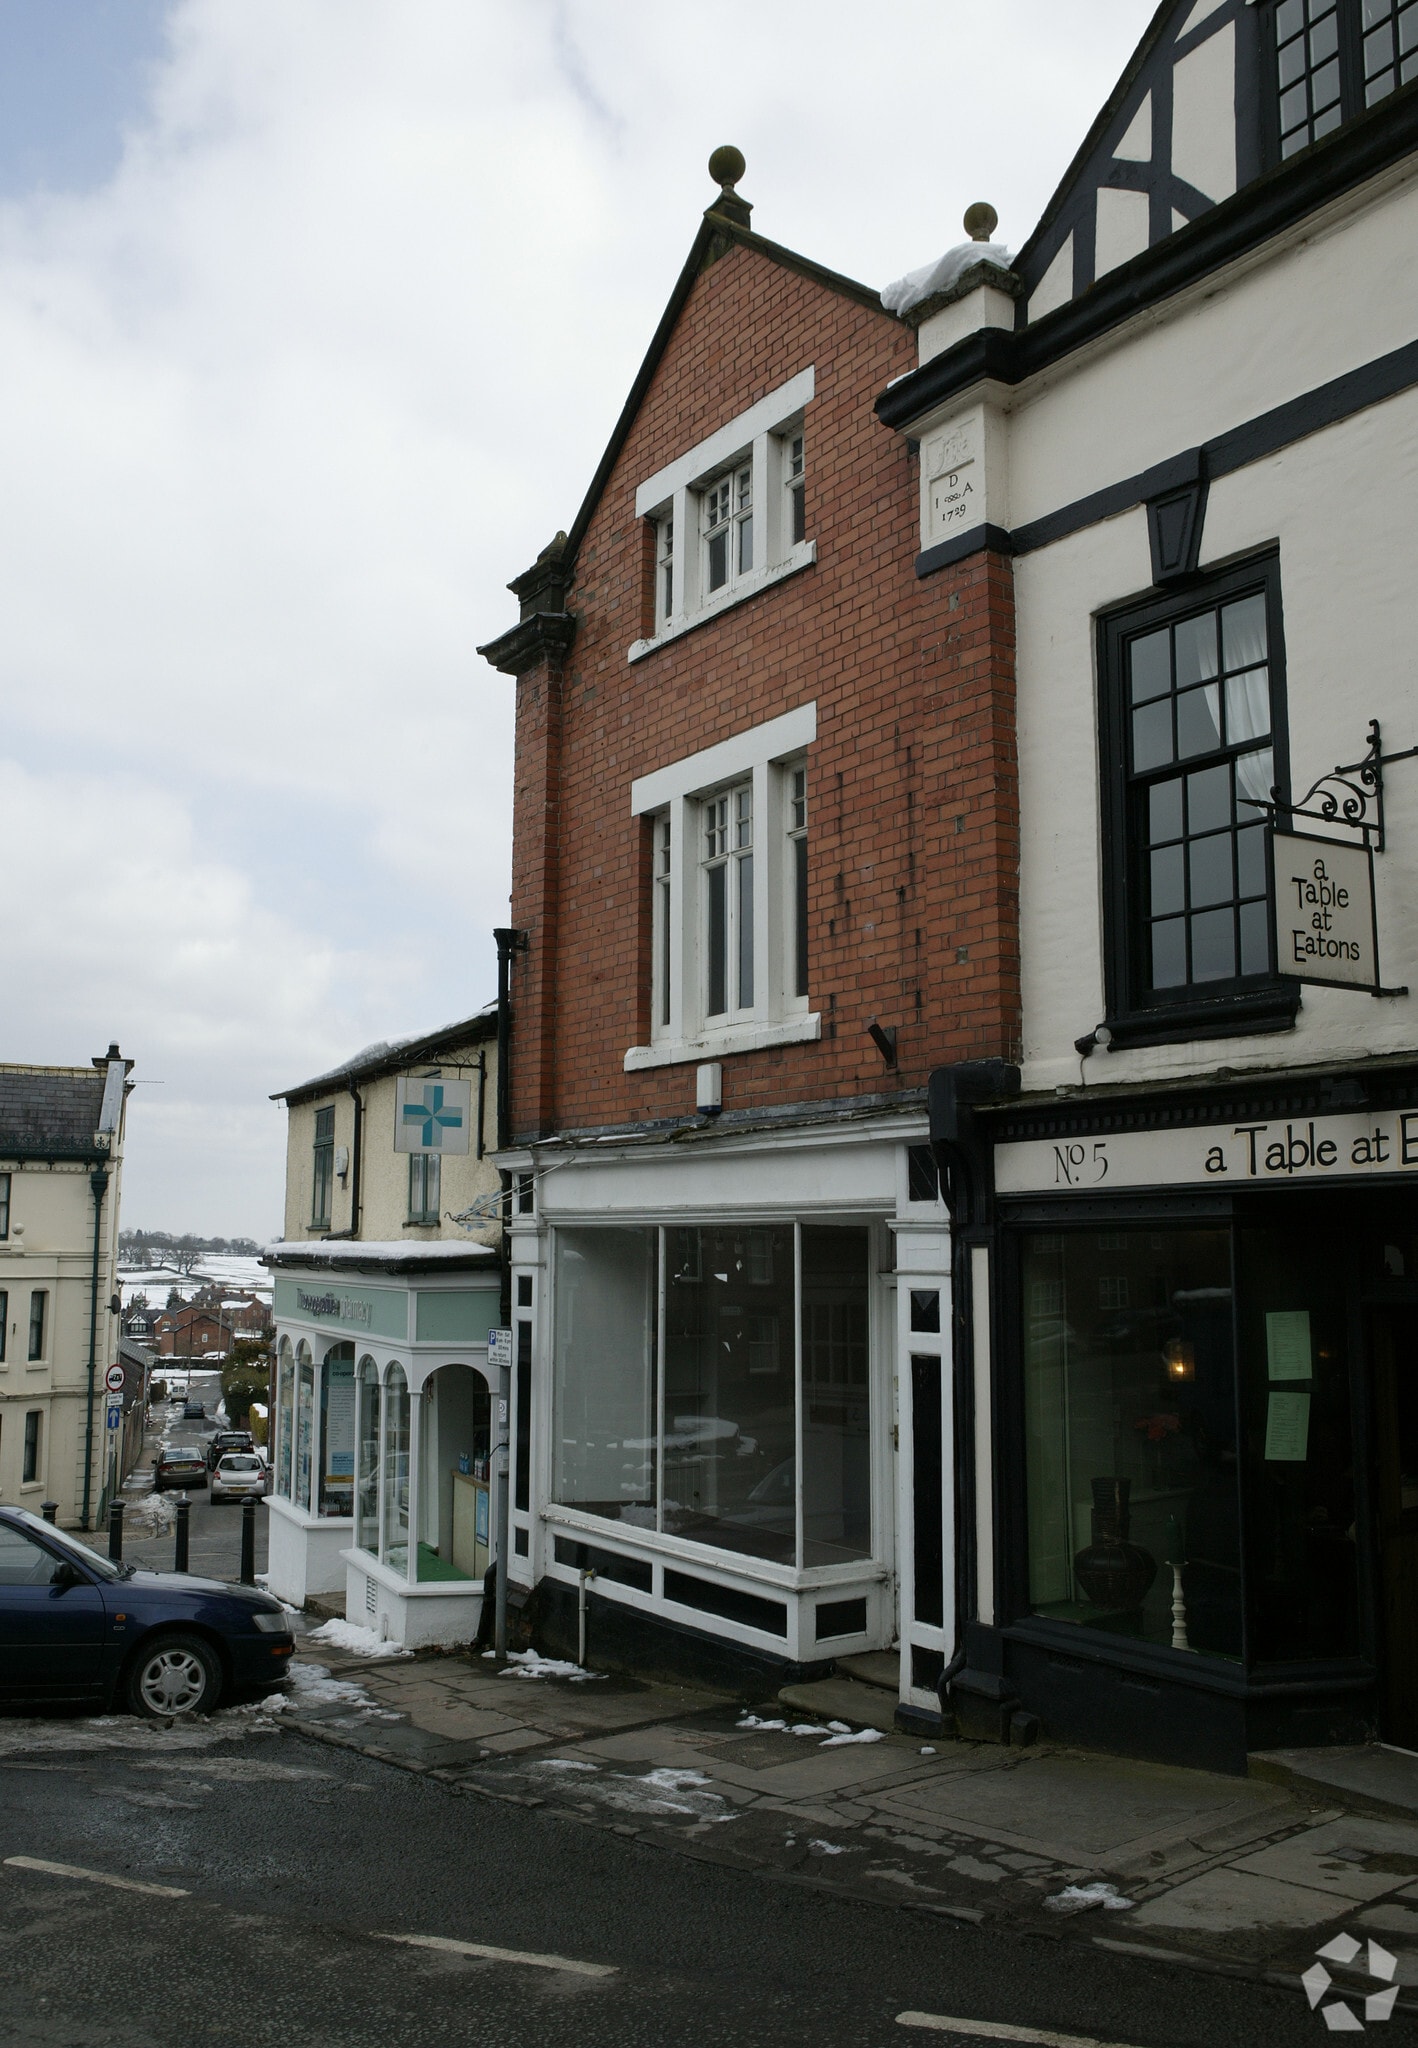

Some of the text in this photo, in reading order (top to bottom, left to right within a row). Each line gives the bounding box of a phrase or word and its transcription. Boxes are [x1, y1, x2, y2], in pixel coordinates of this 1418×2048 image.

[949, 474, 958, 488] D
[962, 482, 973, 497] A
[942, 504, 966, 522] 1729
[1314, 859, 1329, 881] a
[1291, 877, 1349, 909] Table
[1312, 906, 1332, 931] at
[1292, 929, 1360, 962] Eatons
[1205, 1146, 1228, 1173] a
[1234, 1122, 1338, 1176] Table
[1351, 1127, 1390, 1165] at
[1093, 1143, 1108, 1183] 5
[490, 1332, 496, 1344] P
